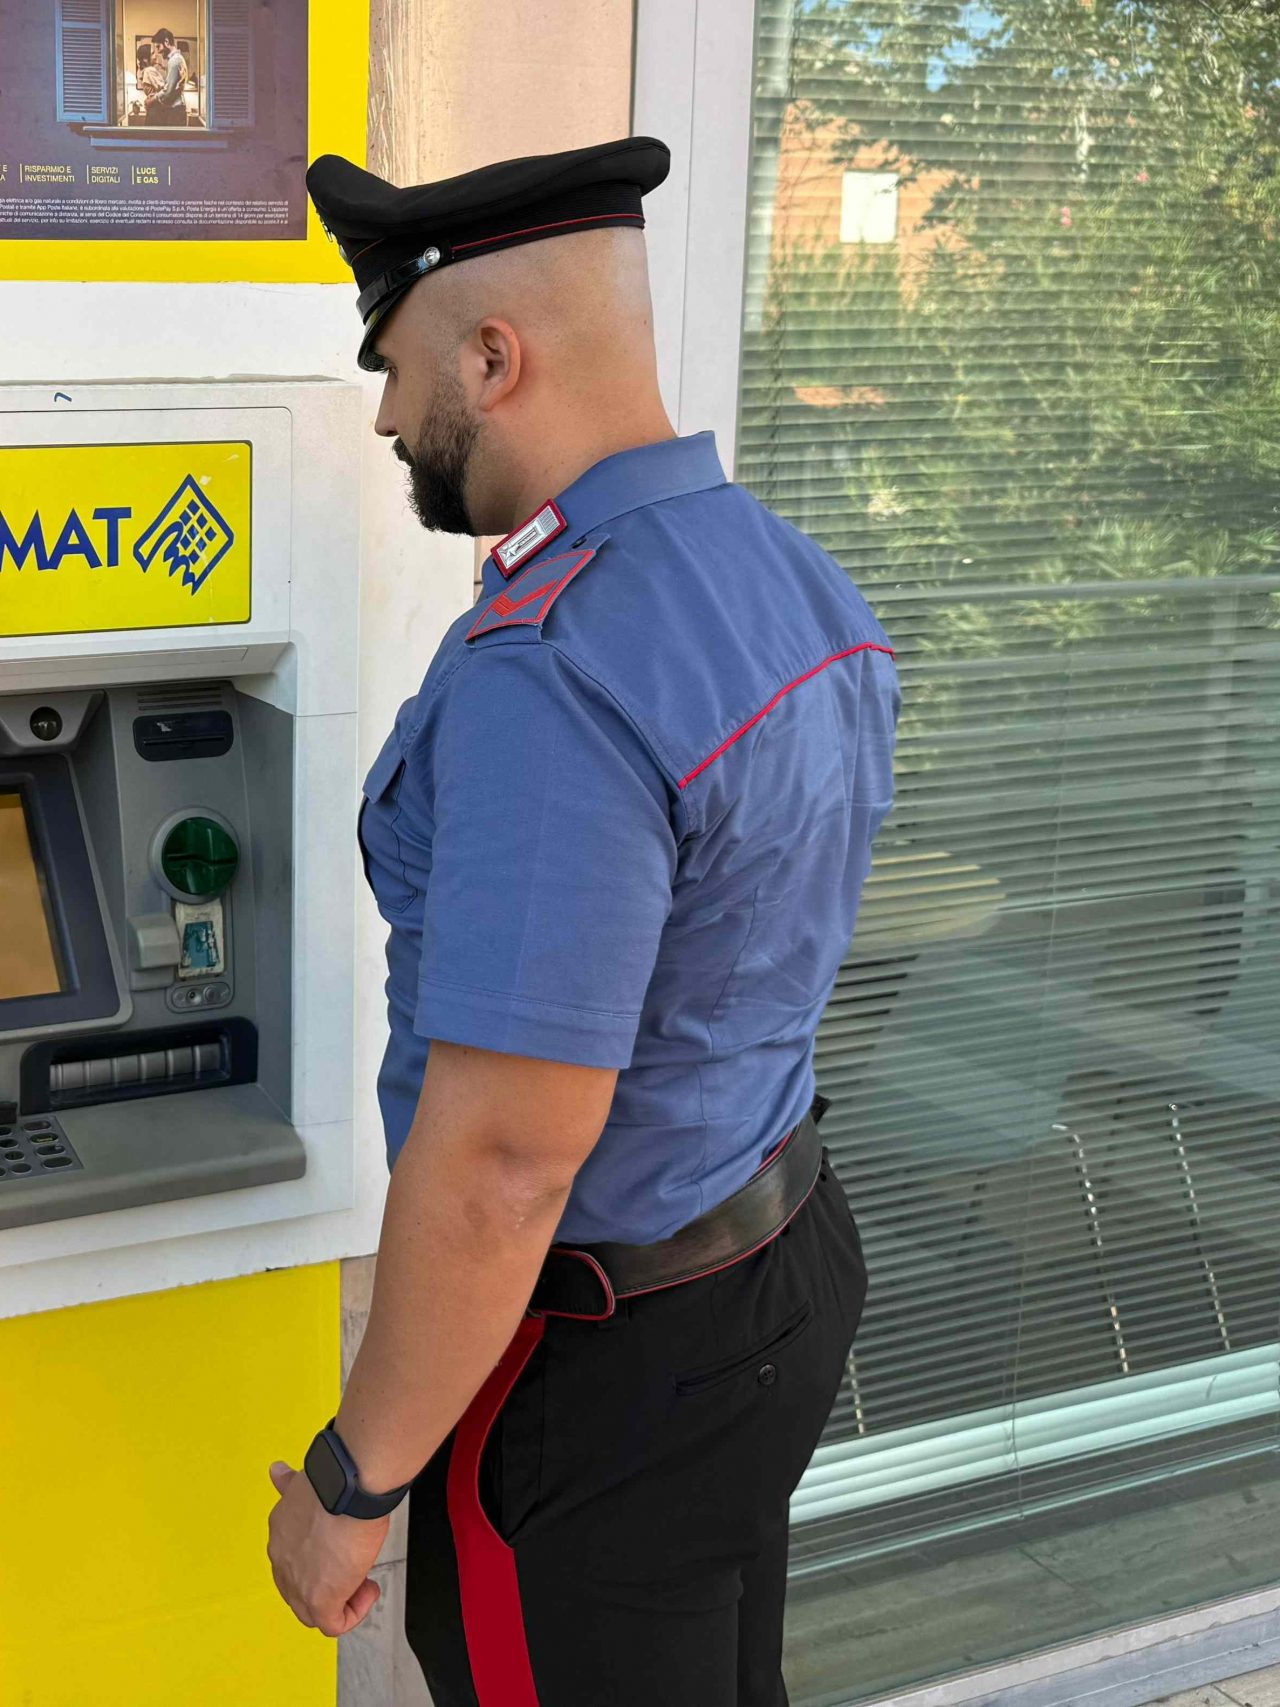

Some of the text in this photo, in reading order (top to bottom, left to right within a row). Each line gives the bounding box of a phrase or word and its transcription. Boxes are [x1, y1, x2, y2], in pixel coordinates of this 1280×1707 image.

[3, 164, 8, 172] E
[24, 165, 72, 174] RISPARMIO E
[91, 166, 118, 174] SERVIZI
[136, 167, 156, 175] LUCE
[24, 174, 75, 183] INVESTIMENTI
[91, 175, 121, 183] DIGITALI
[143, 176, 159, 184] GAS
